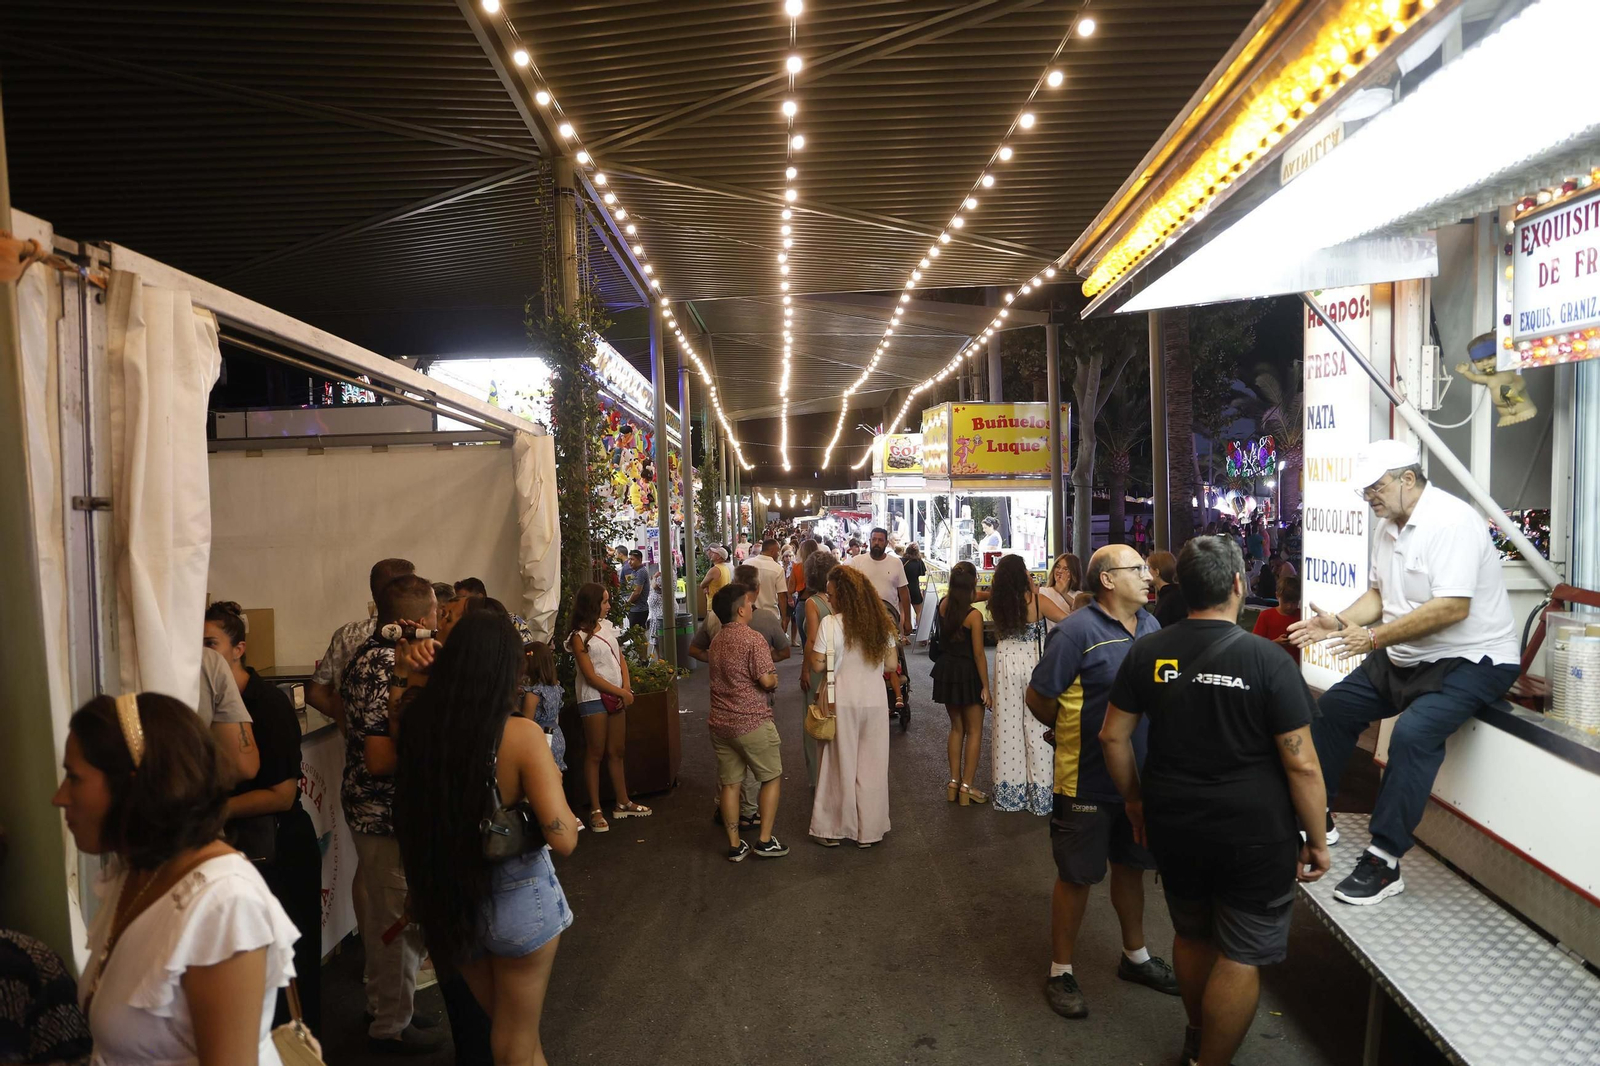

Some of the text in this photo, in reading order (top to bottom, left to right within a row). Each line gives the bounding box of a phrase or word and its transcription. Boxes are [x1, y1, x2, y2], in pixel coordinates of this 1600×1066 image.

[1538, 257, 1560, 288] DE
[1307, 351, 1347, 380] FRESA
[1307, 404, 1336, 430] NATA
[986, 439, 1040, 455] Luque
[1305, 507, 1363, 536] CHOCOLATE
[1305, 556, 1356, 588] TURRON
[1164, 669, 1245, 690] PRGESA
